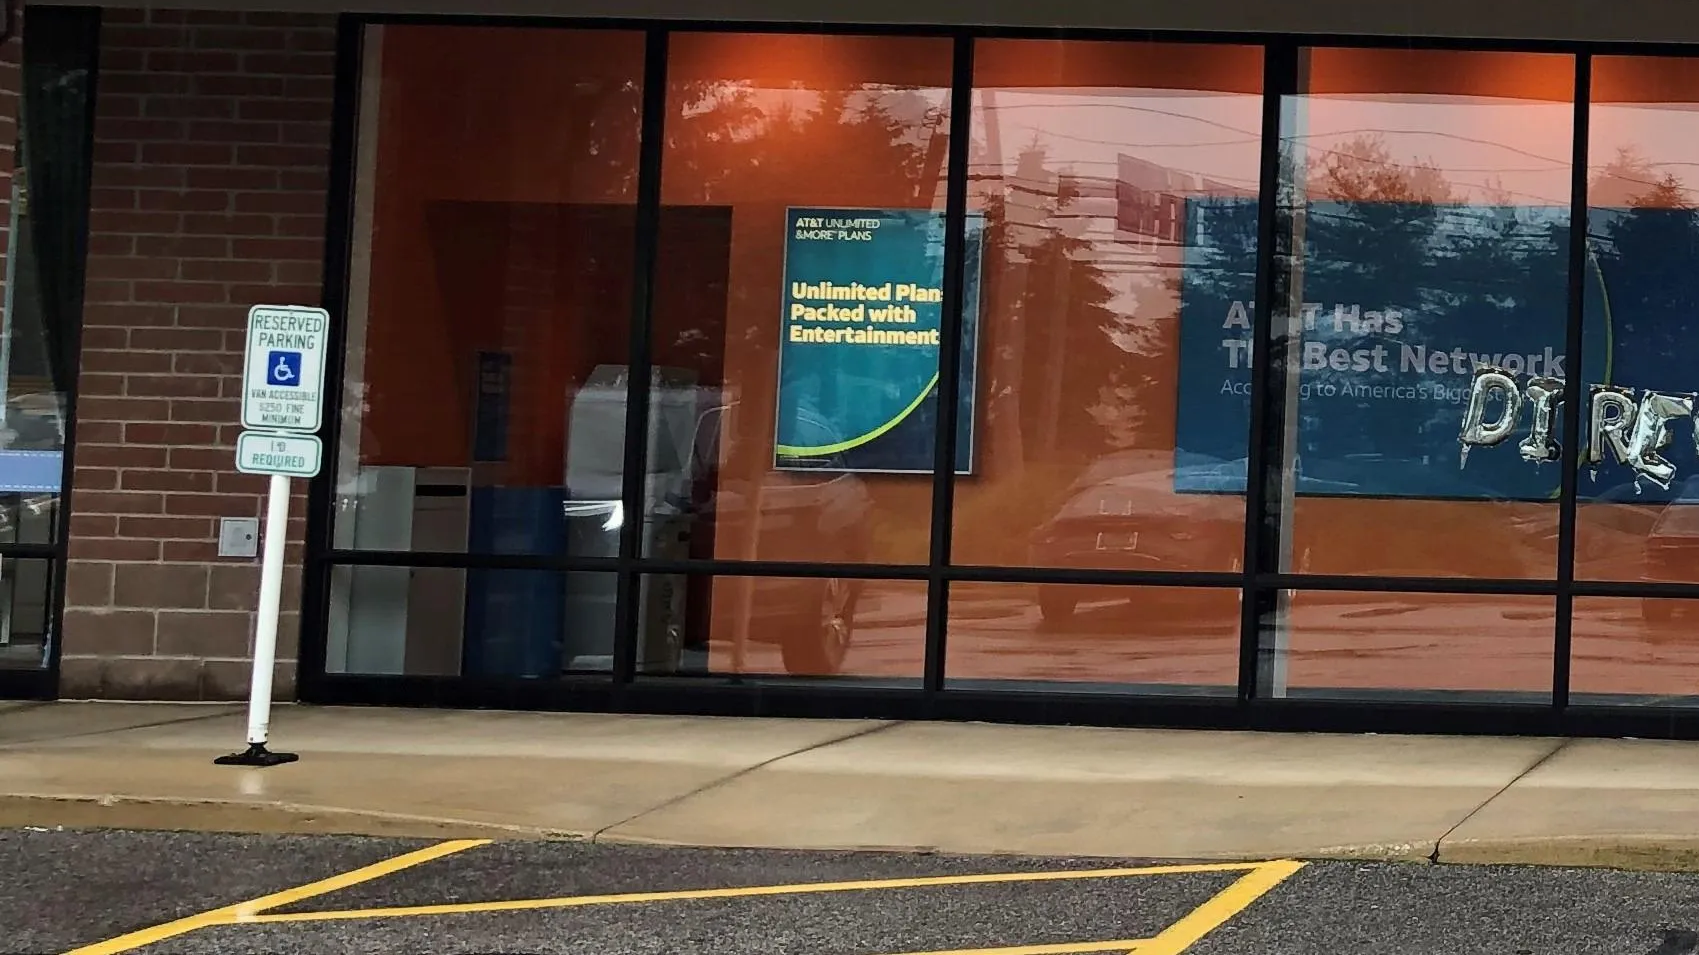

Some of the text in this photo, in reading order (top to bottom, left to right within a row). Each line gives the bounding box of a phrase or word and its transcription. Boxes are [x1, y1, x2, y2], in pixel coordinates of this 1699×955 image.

[796, 217, 881, 229] AT&T UNLIMITED
[837, 230, 872, 241] PLANS
[791, 281, 892, 301] Unlimited
[790, 303, 917, 323] Packed with
[1333, 303, 1404, 334] Has
[254, 314, 322, 333] RESERVED
[258, 332, 315, 350] PARKING
[789, 324, 940, 345] Entertainment
[1302, 341, 1566, 377] Best Network
[251, 389, 266, 400] VAN
[1316, 383, 1337, 397] to
[1341, 383, 1428, 400] America's
[1433, 383, 1503, 404] Biggst
[286, 403, 305, 415] FINE
[261, 414, 302, 425] MINIMUM
[252, 453, 305, 468] REQUIRED
